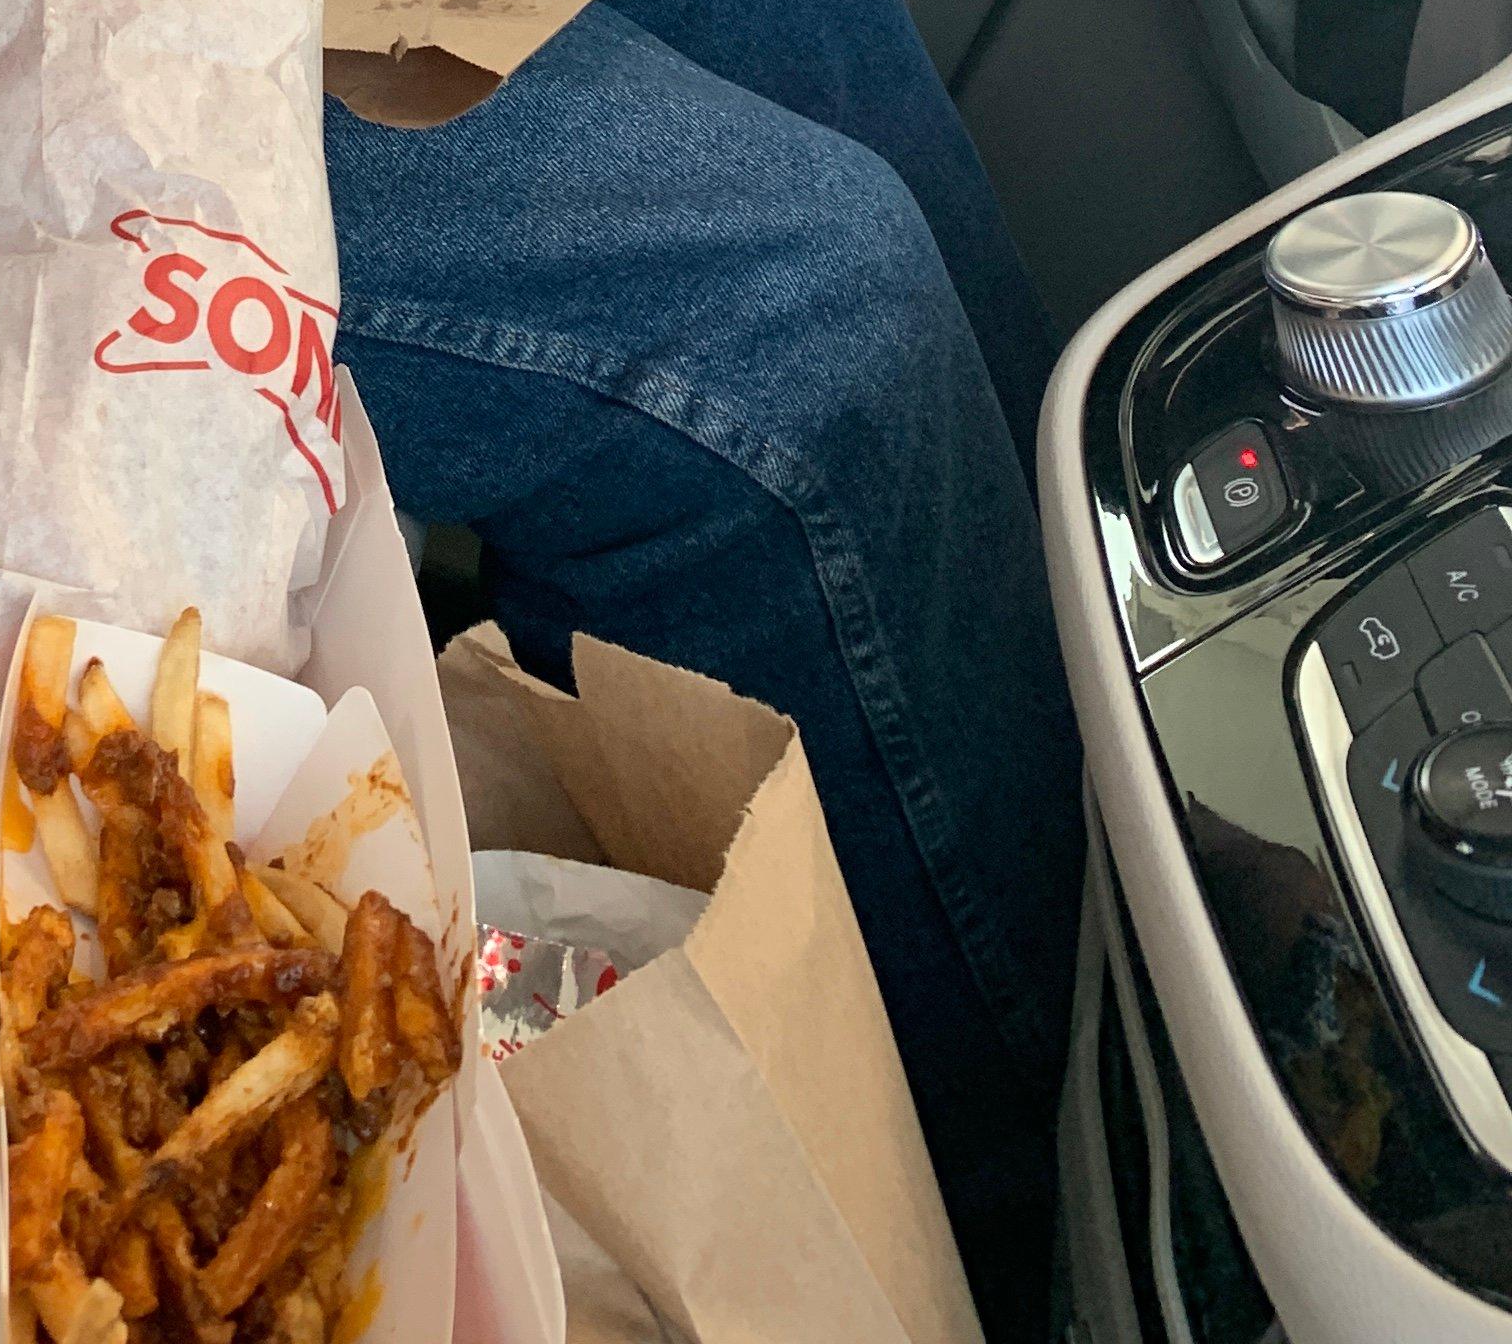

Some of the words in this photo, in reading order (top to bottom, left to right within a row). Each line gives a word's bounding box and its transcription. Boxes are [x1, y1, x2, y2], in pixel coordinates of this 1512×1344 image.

[126, 251, 342, 445] SON
[1445, 570, 1479, 603] A/C
[1464, 766, 1499, 810] MODE
